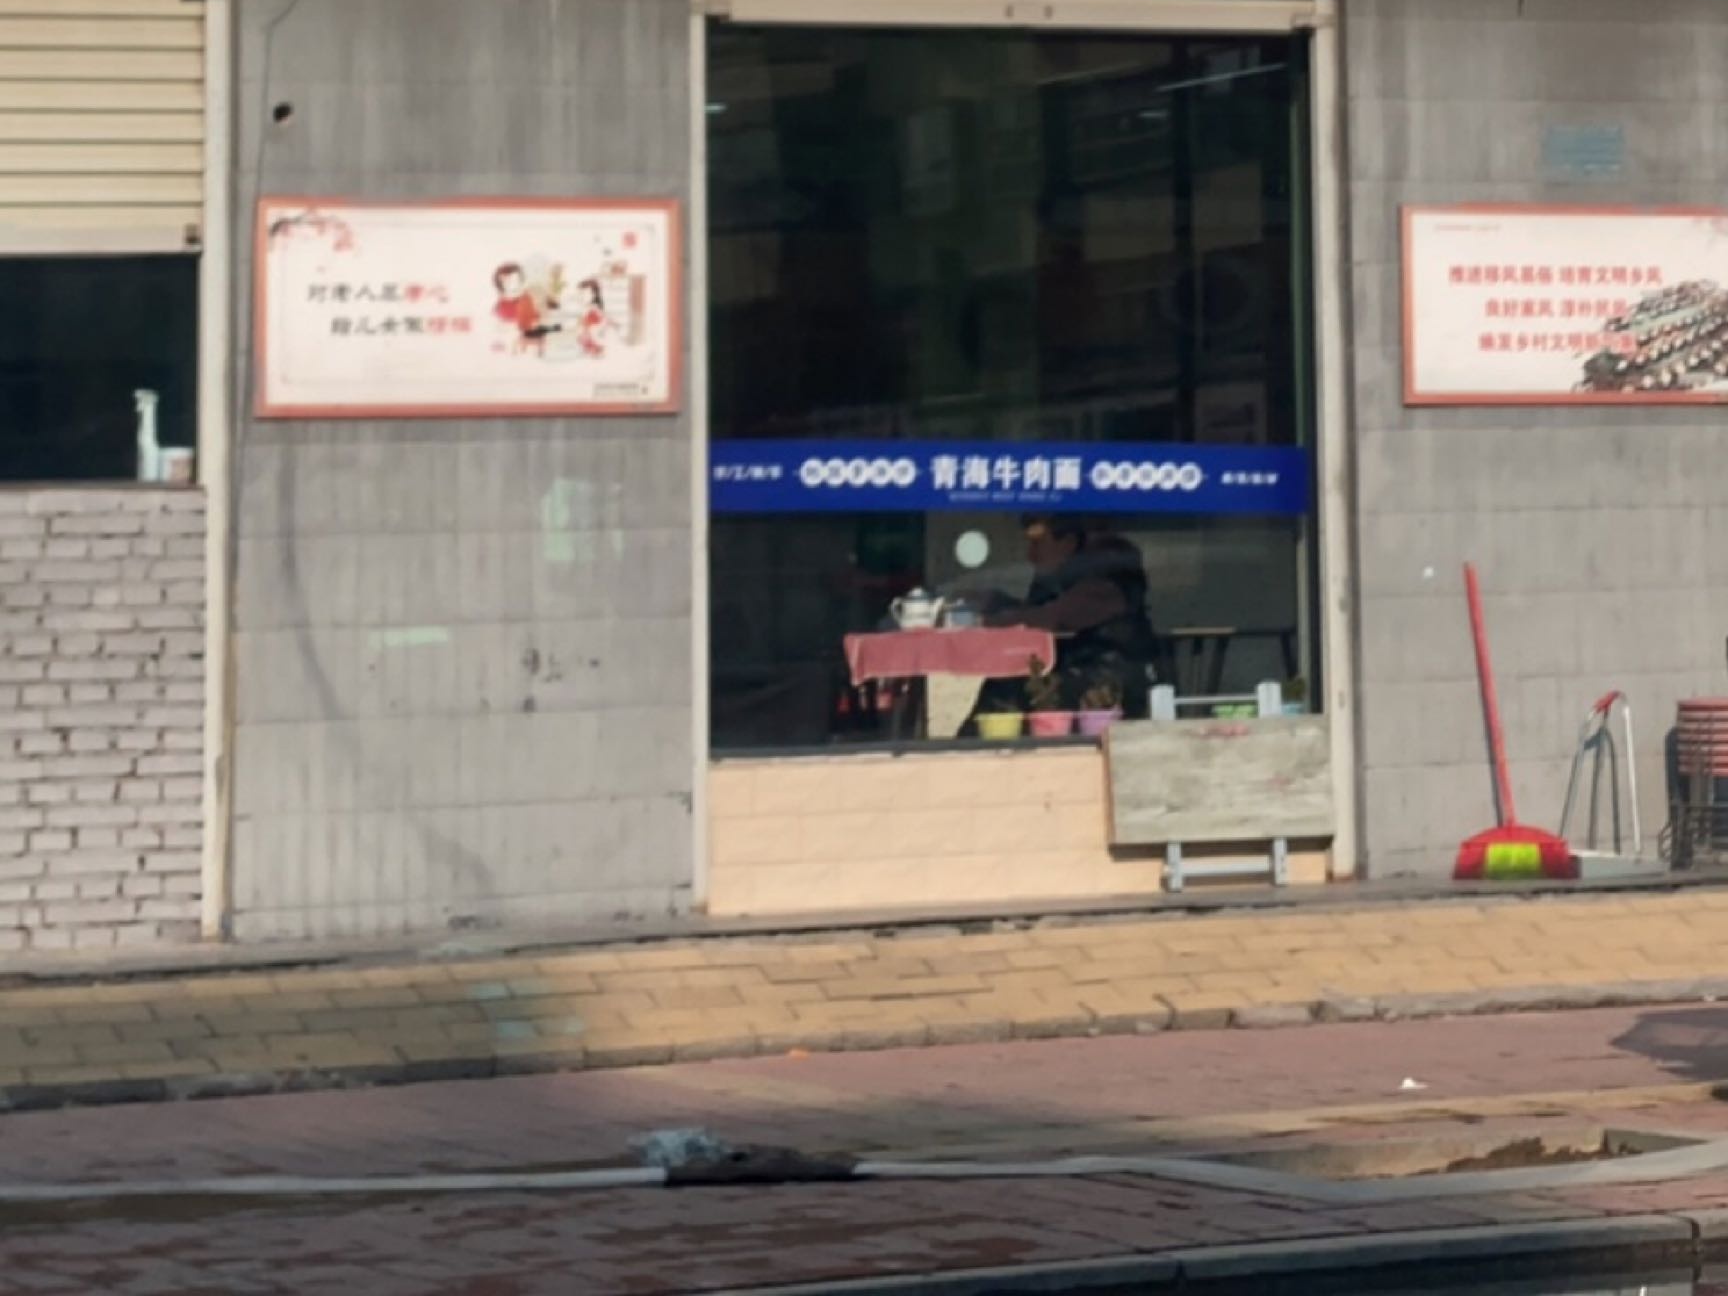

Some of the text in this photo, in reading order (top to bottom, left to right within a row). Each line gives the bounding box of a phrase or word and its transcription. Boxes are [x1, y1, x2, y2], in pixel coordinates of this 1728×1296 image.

[929, 454, 1082, 491] 青海牛肉面
